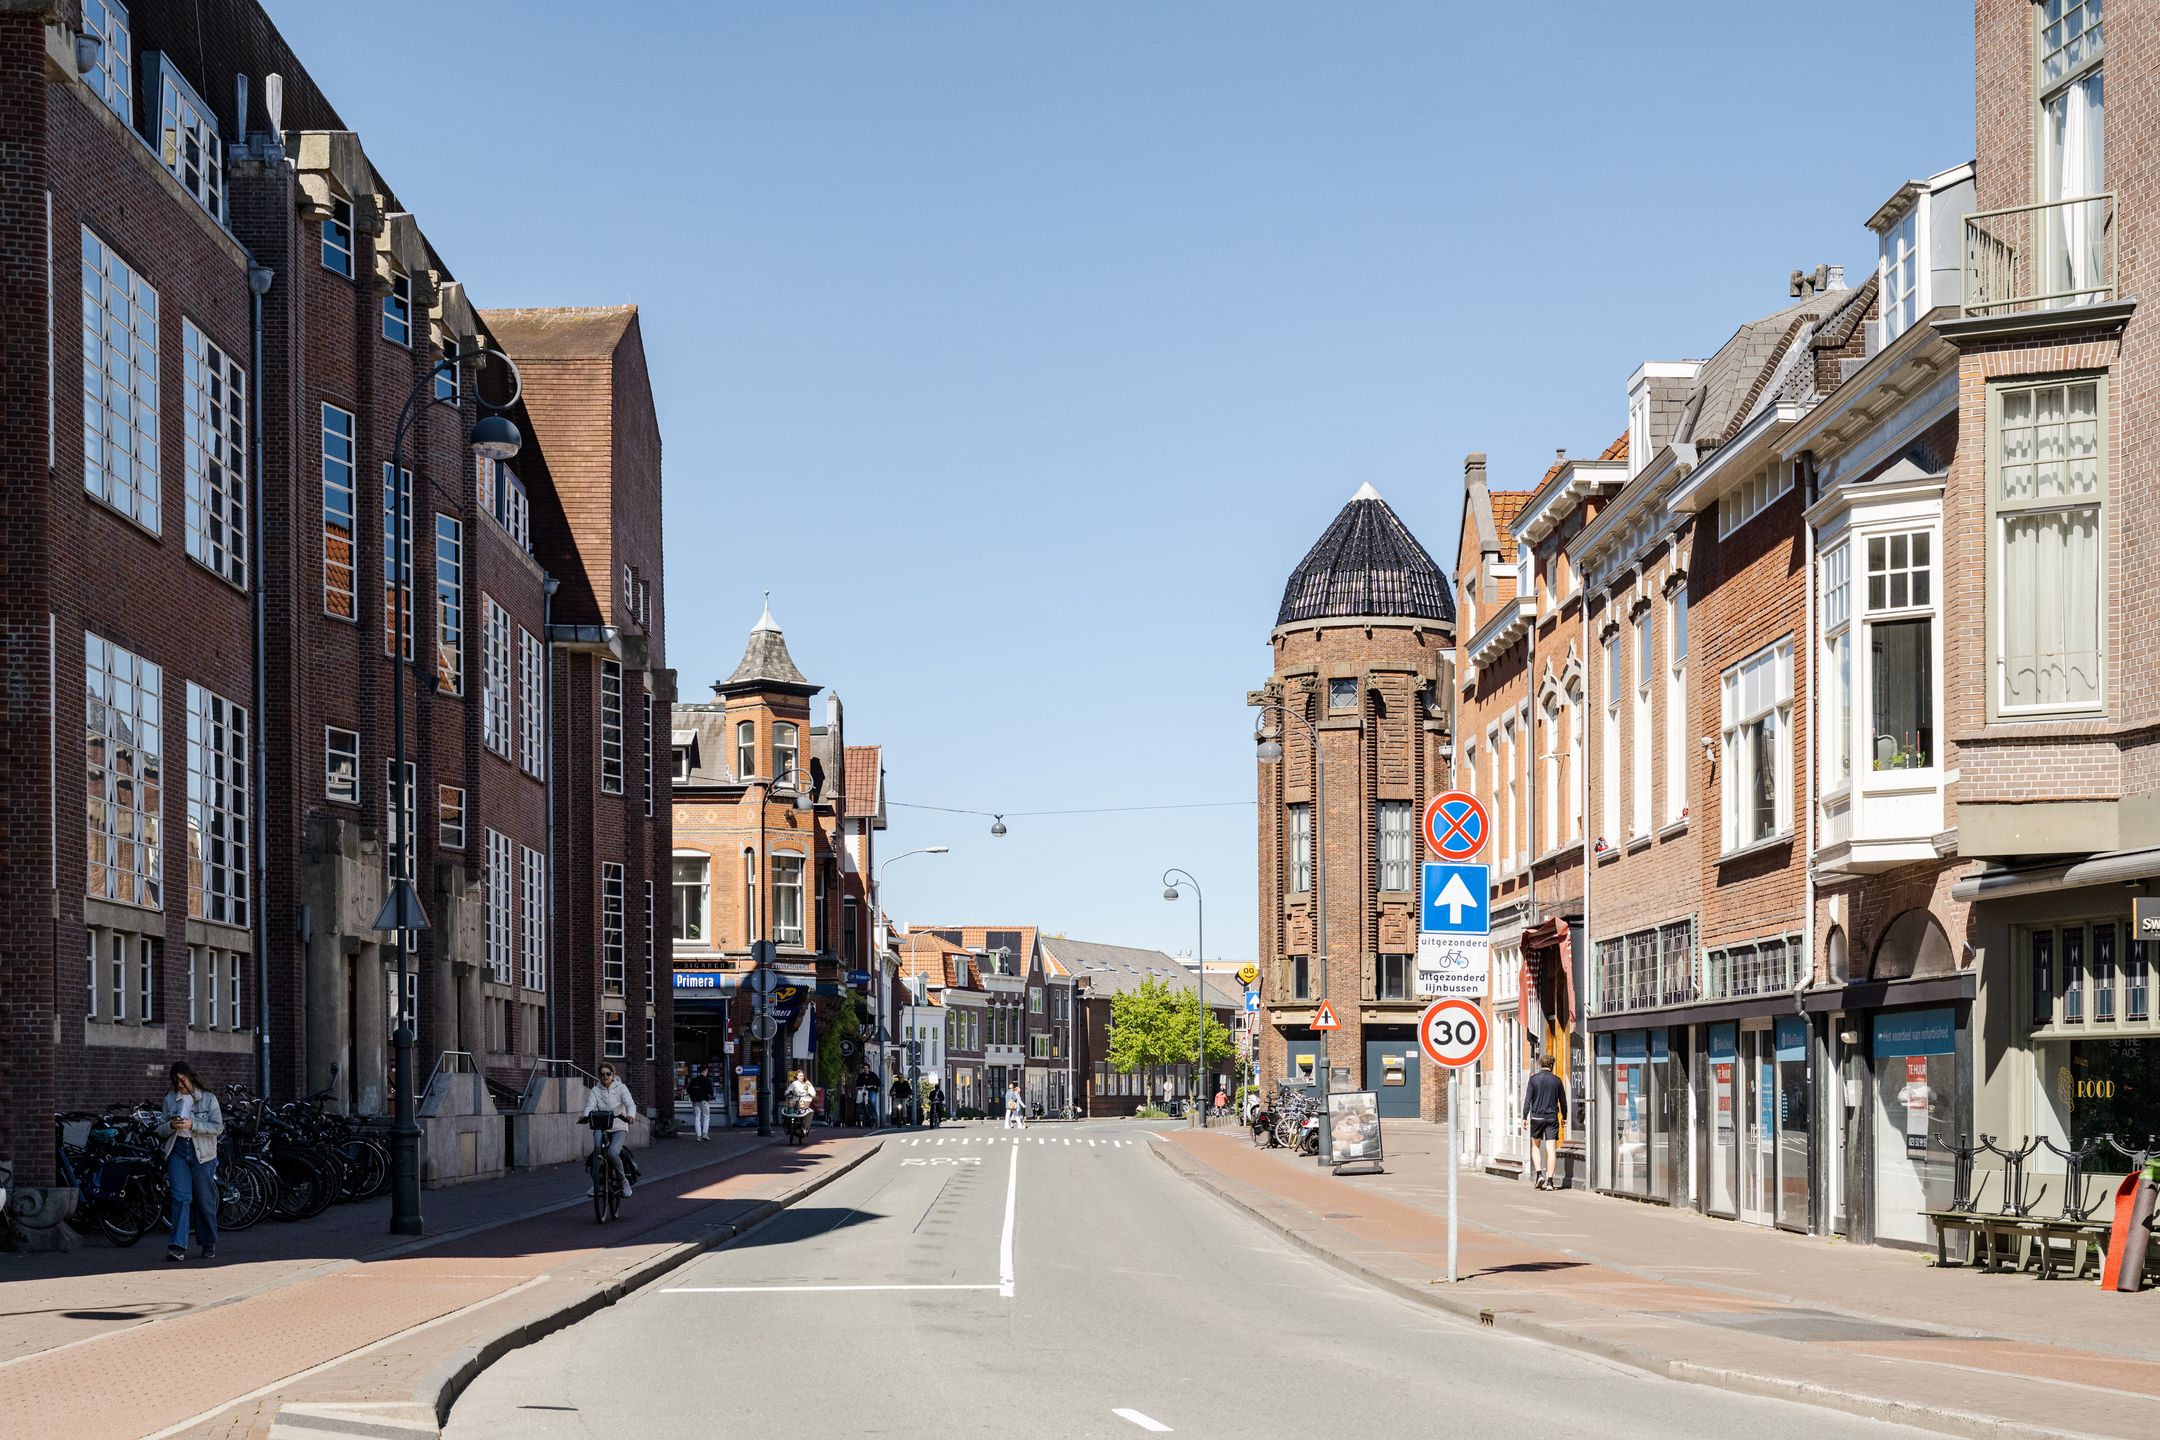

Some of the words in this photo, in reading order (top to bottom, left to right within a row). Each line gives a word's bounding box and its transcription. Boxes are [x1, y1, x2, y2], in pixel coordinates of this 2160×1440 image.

[1421, 938, 1488, 948] uitgezonderd
[677, 974, 714, 987] Primera
[1419, 973, 1486, 983] uitgezonderd
[1425, 984, 1478, 993] lijnbussen
[1433, 1020, 1476, 1046] 30
[2077, 1080, 2115, 1098] ROOD
[1353, 1123, 1372, 1133] Way
